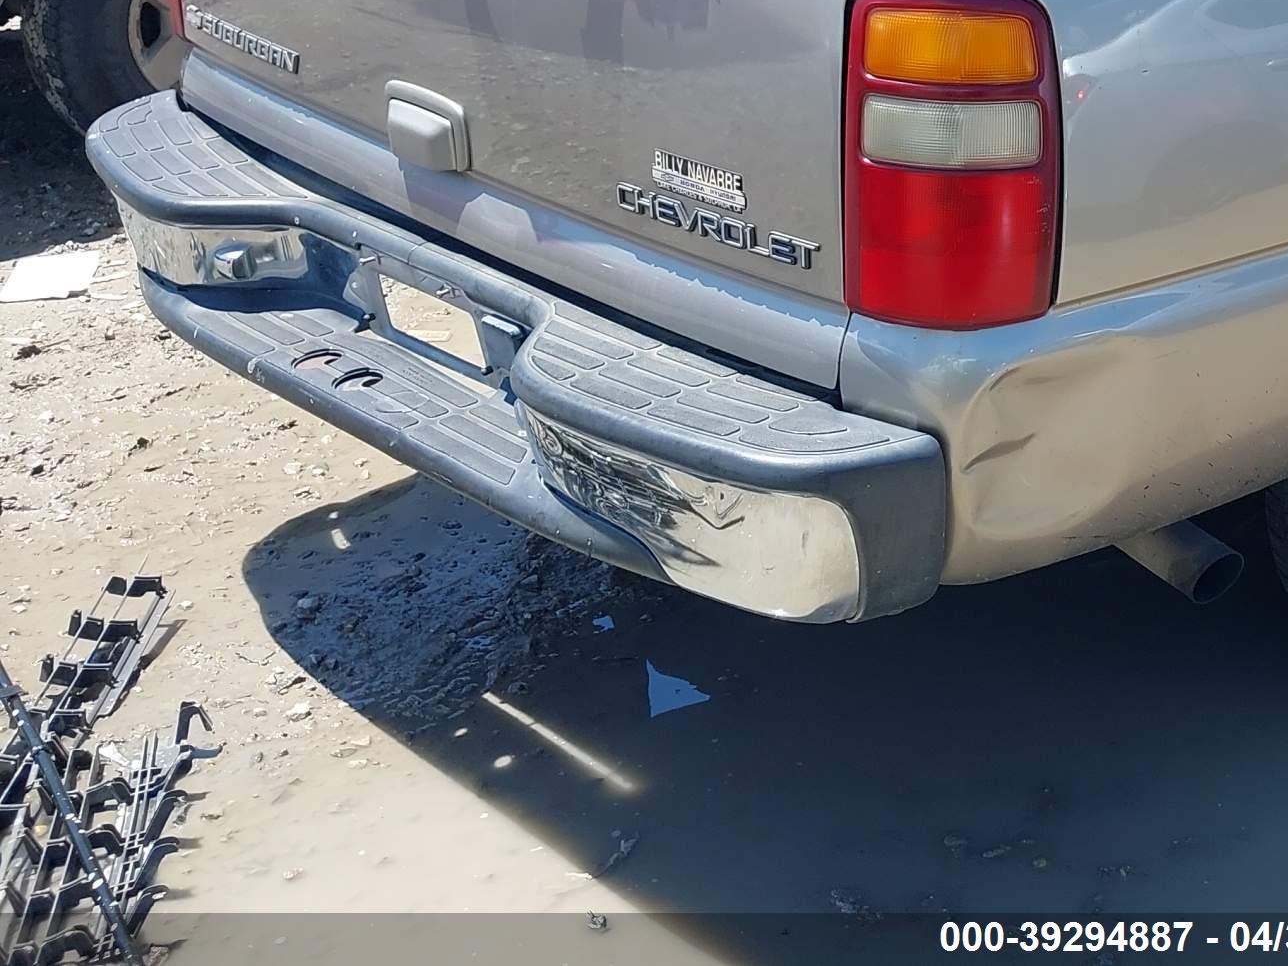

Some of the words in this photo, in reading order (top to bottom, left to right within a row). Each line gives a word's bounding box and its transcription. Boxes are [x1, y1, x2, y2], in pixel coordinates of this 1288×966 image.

[201, 11, 300, 75] SUBURBAN
[654, 150, 684, 176] BILLY
[687, 160, 742, 192] NAVARRE
[616, 181, 820, 270] CHEVROLET
